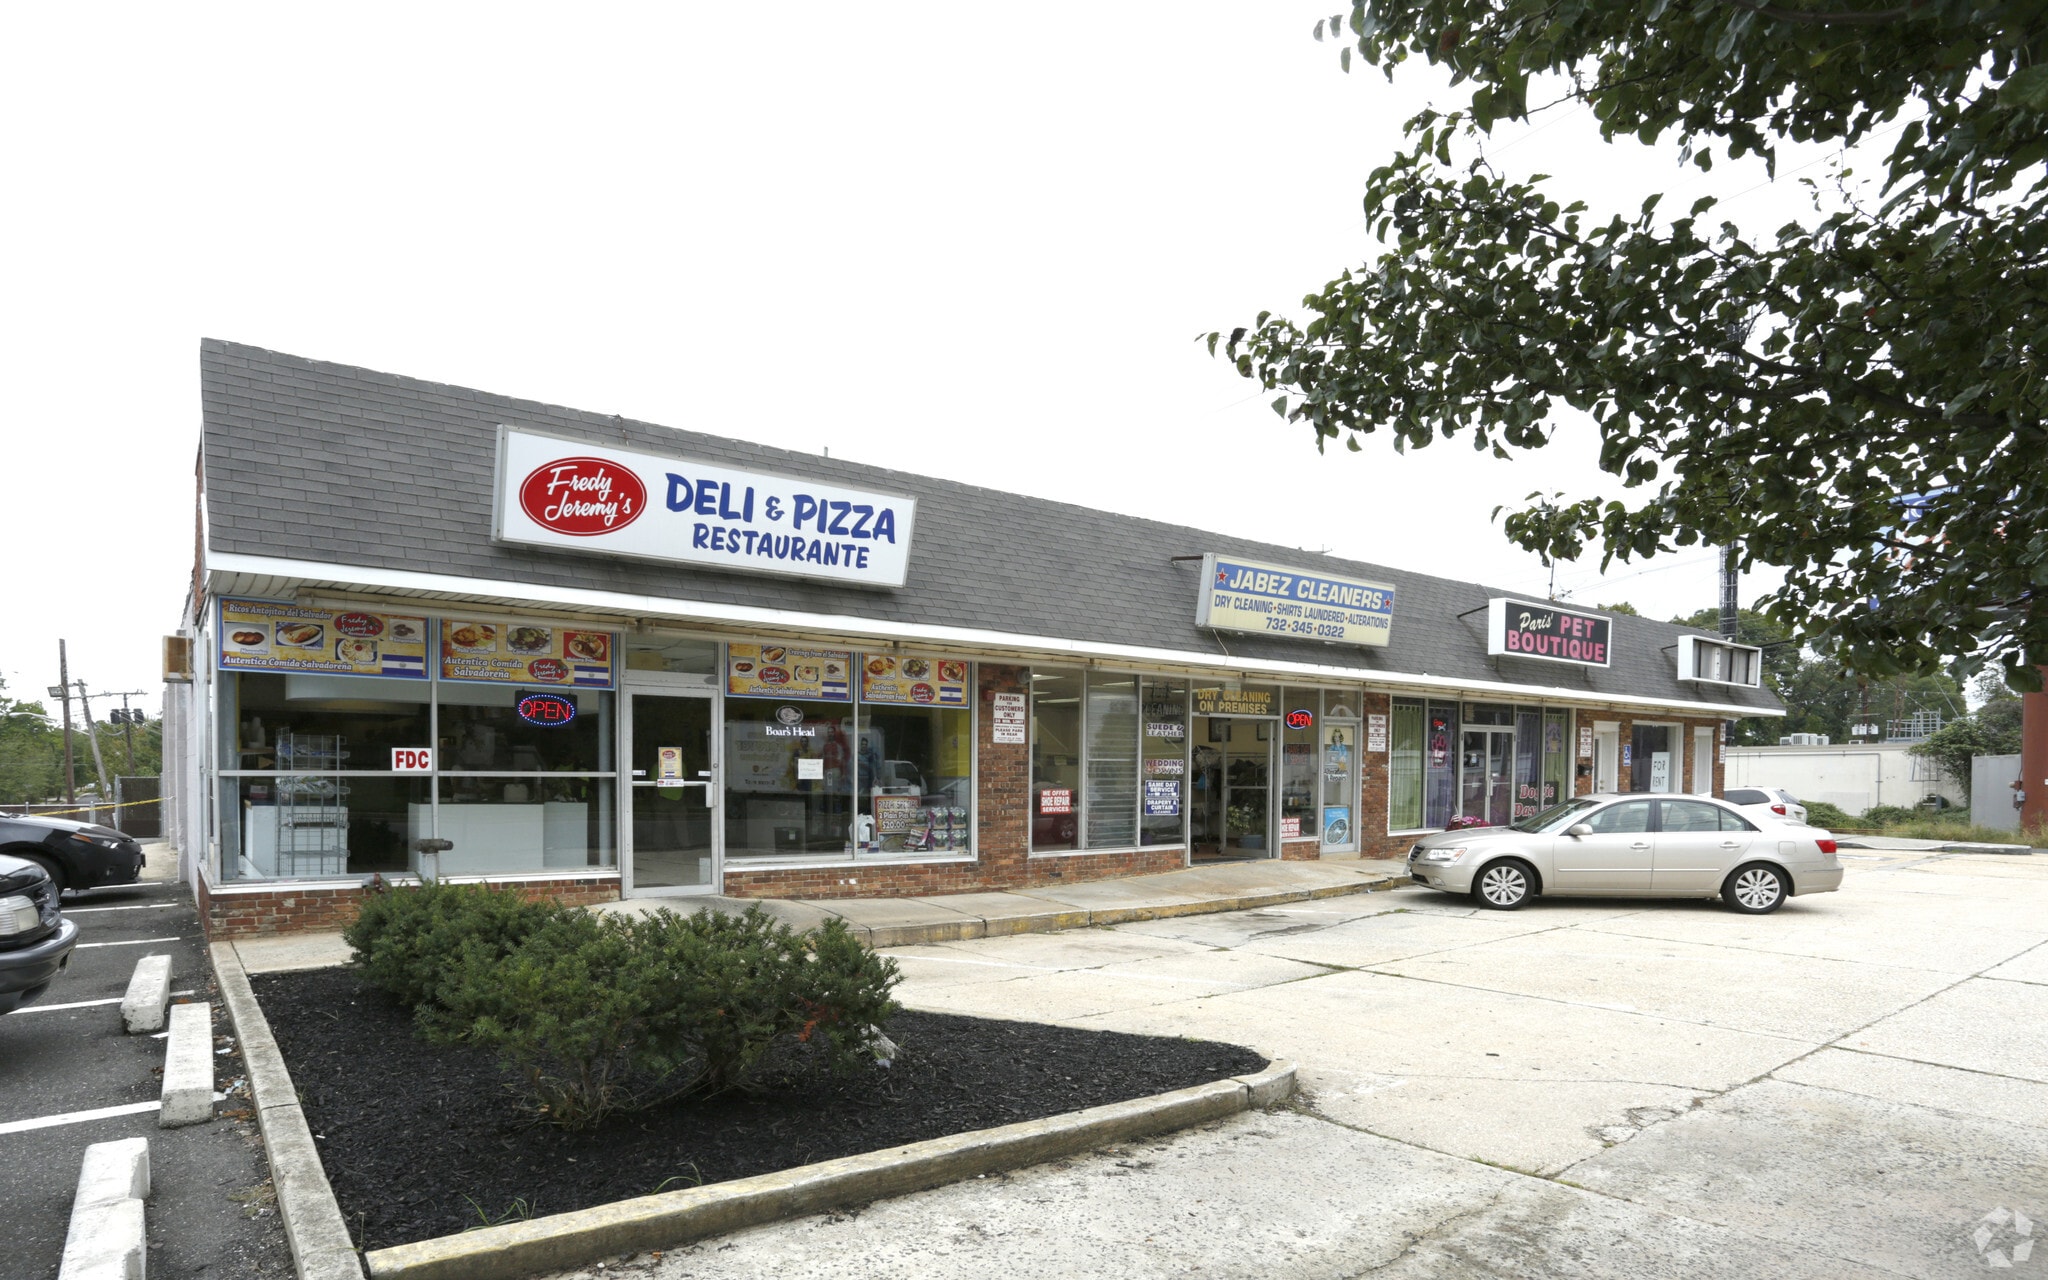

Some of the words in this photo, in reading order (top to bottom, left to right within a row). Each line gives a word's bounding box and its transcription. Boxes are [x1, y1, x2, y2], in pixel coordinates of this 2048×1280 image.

[547, 464, 612, 501] Fredy
[544, 490, 632, 527] Jeremy's
[665, 472, 754, 523] DELI
[766, 498, 785, 522] &
[792, 494, 896, 544] PIZZA
[693, 523, 870, 569] RESTAURANTE
[1229, 569, 1292, 596] JABEZ
[1296, 580, 1383, 610] CLEANERS
[229, 604, 249, 613] Ricos
[250, 605, 286, 616] Antojitos
[287, 609, 298, 617] del
[300, 609, 332, 619] Salvador
[1214, 595, 1231, 609] DRY
[1234, 597, 1273, 614] CLEANING
[1276, 603, 1303, 618] SHIRTS
[1304, 608, 1345, 624] LAUNDERED
[1348, 613, 1389, 629] ALTERATIONS
[1519, 612, 1553, 633] Paris'
[1560, 615, 1595, 638] PET
[1508, 630, 1604, 662] BOUTIQUE
[810, 649, 823, 658] from
[223, 655, 267, 666] Autentica
[268, 658, 300, 667] Comida
[301, 660, 352, 671] Salvadoreña
[445, 656, 488, 666] Autentica
[491, 659, 523, 669] Comida
[454, 667, 510, 678] Salvadoreña
[749, 685, 774, 694] Authentic
[806, 688, 818, 696] Food
[871, 683, 898, 691] Authentic
[895, 693, 907, 701] Food
[1197, 689, 1217, 700] DRY
[1223, 690, 1271, 703] CLEANING
[520, 700, 570, 720] OPEN
[1199, 700, 1214, 712] ON
[1218, 701, 1267, 714] PREMISES
[1286, 713, 1312, 726] OPEN
[765, 726, 791, 736] Boar's
[792, 727, 816, 737] Head
[395, 750, 429, 769] FDC
[1653, 760, 1666, 770] FOR
[1652, 776, 1665, 787] RENT
[1519, 784, 1555, 801] Doie
[882, 820, 905, 830] $20.00
